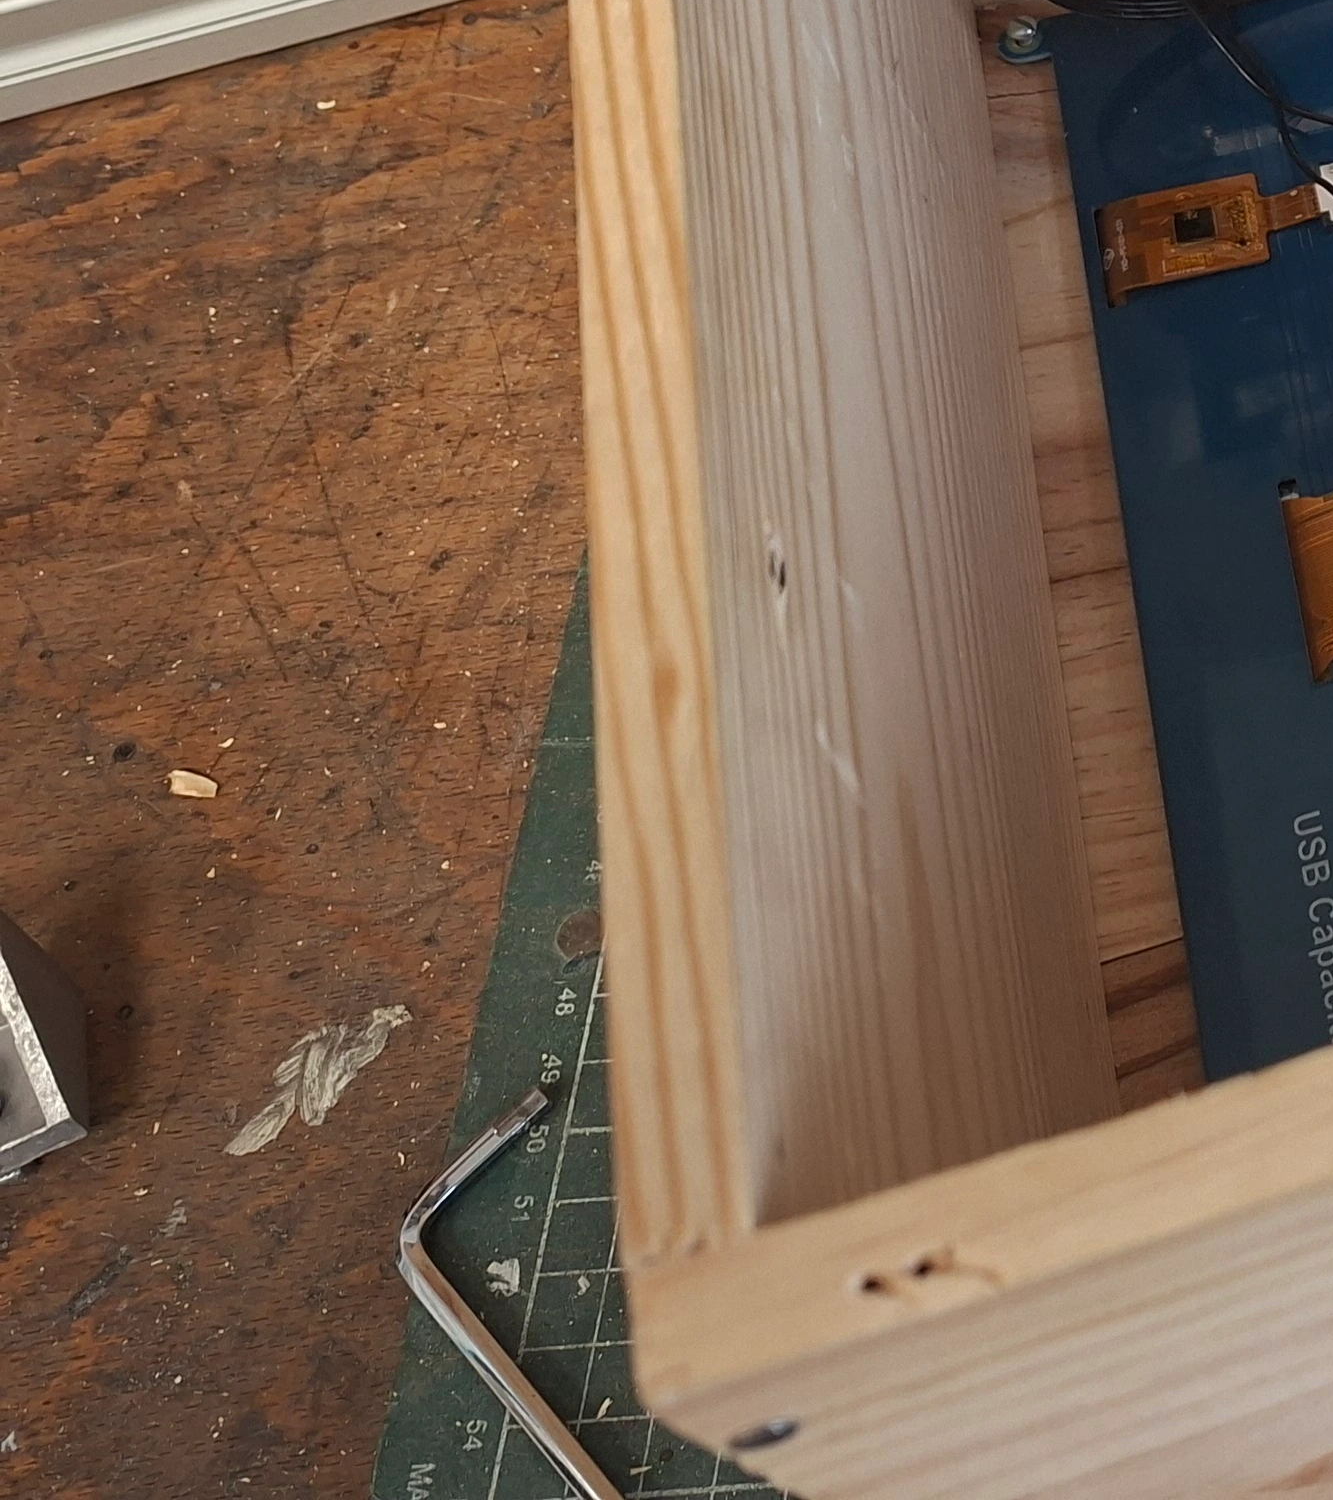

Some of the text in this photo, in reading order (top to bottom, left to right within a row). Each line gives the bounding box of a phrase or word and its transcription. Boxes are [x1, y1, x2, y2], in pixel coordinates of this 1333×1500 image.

[1293, 809, 1333, 887] USB
[553, 986, 576, 1017] 48
[525, 1122, 550, 1155] 50
[462, 1418, 488, 1453] 54
